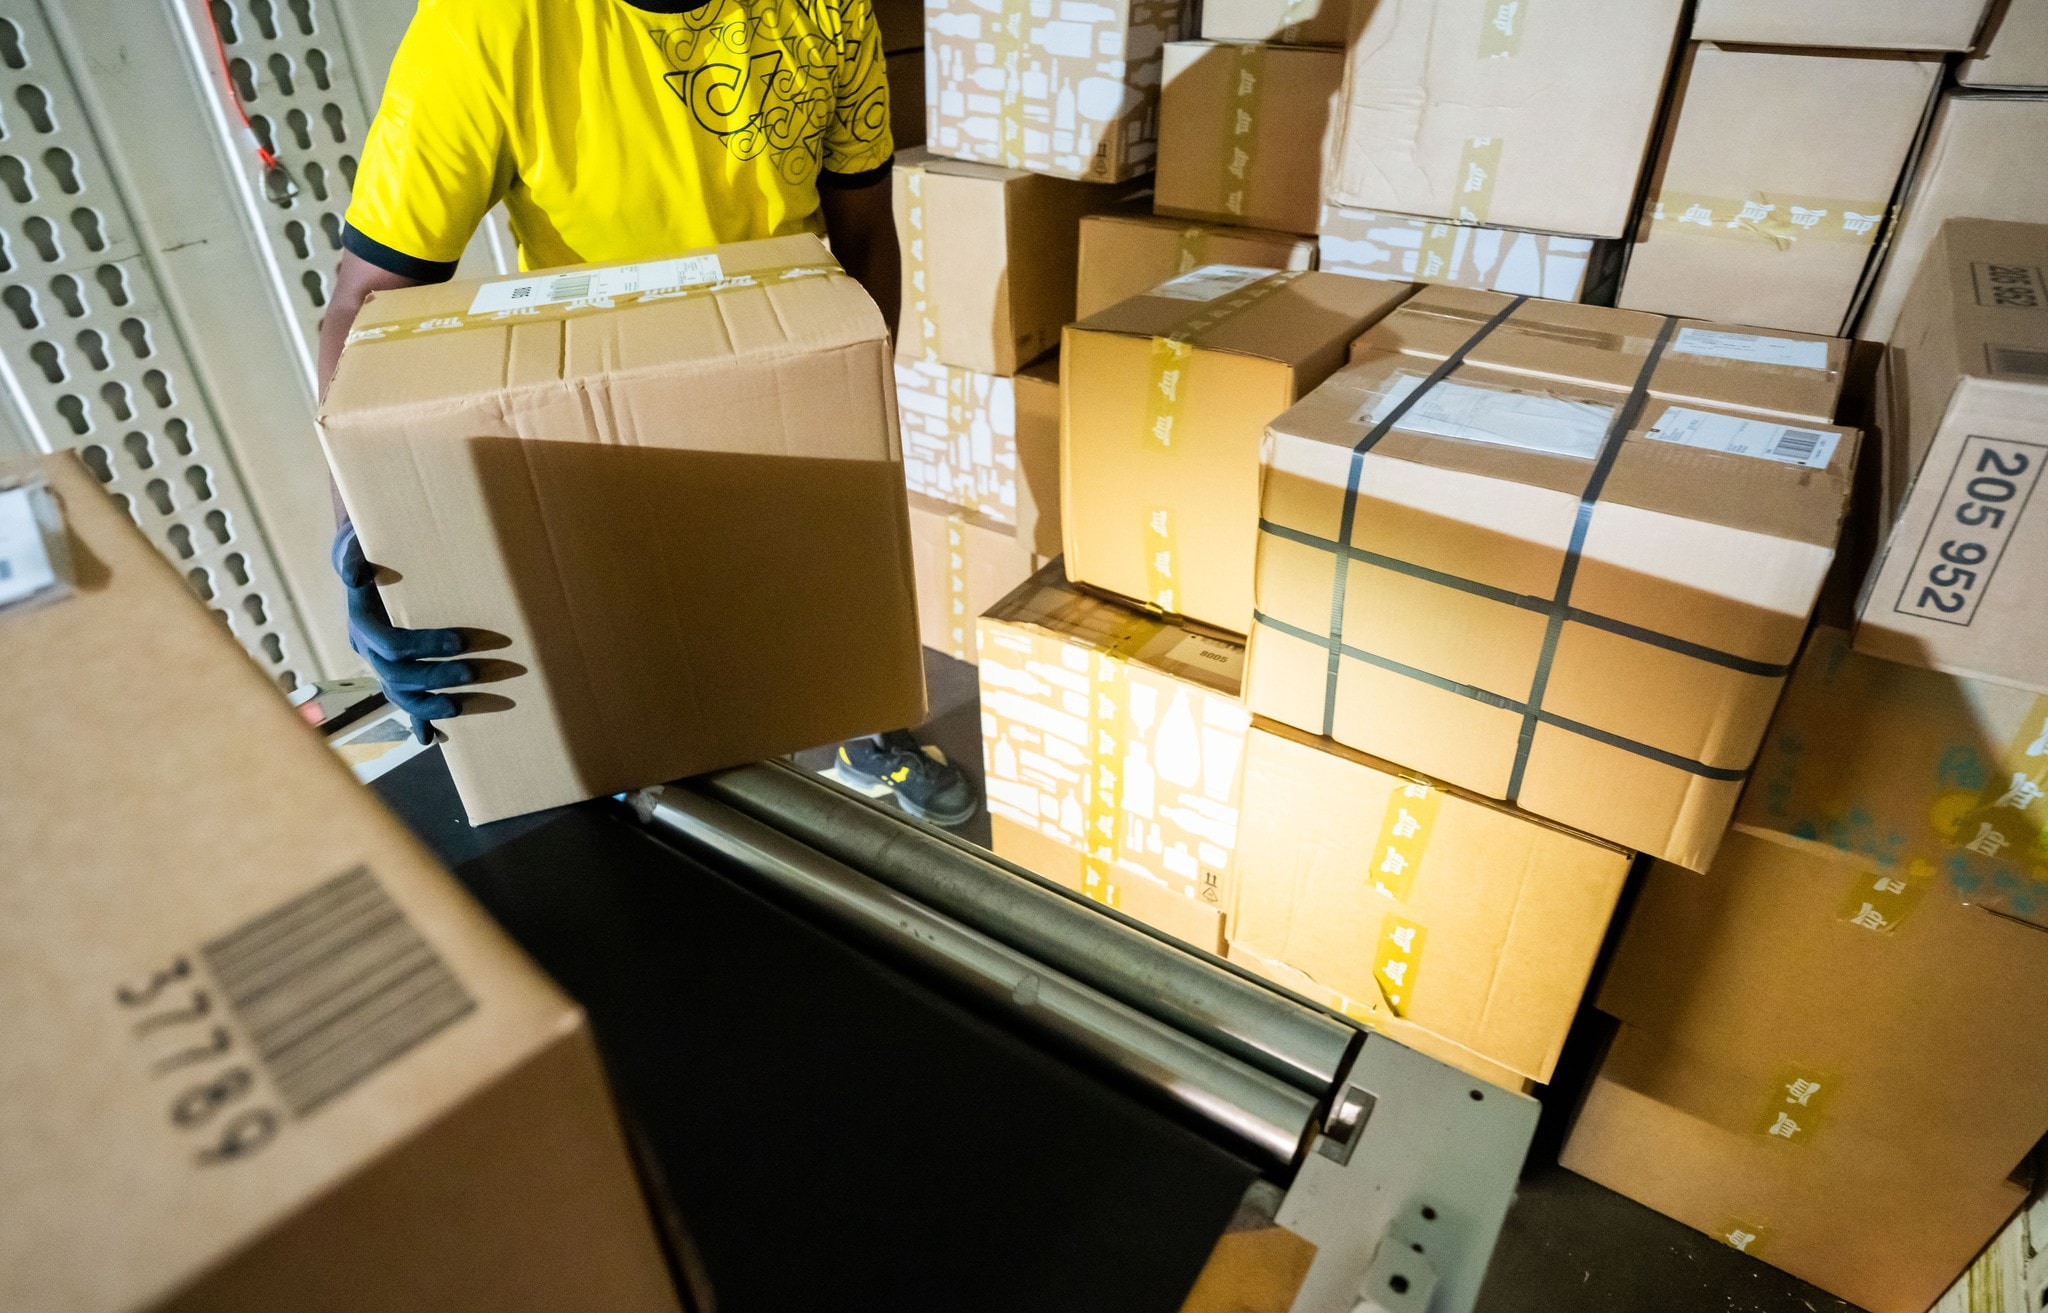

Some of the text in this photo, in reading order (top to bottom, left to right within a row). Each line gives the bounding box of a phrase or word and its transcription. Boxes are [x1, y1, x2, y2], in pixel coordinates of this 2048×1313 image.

[1152, 415, 1174, 447] dm
[1158, 369, 1180, 402] dm
[1916, 448, 2029, 613] 205 952
[115, 953, 280, 1168] 37789
